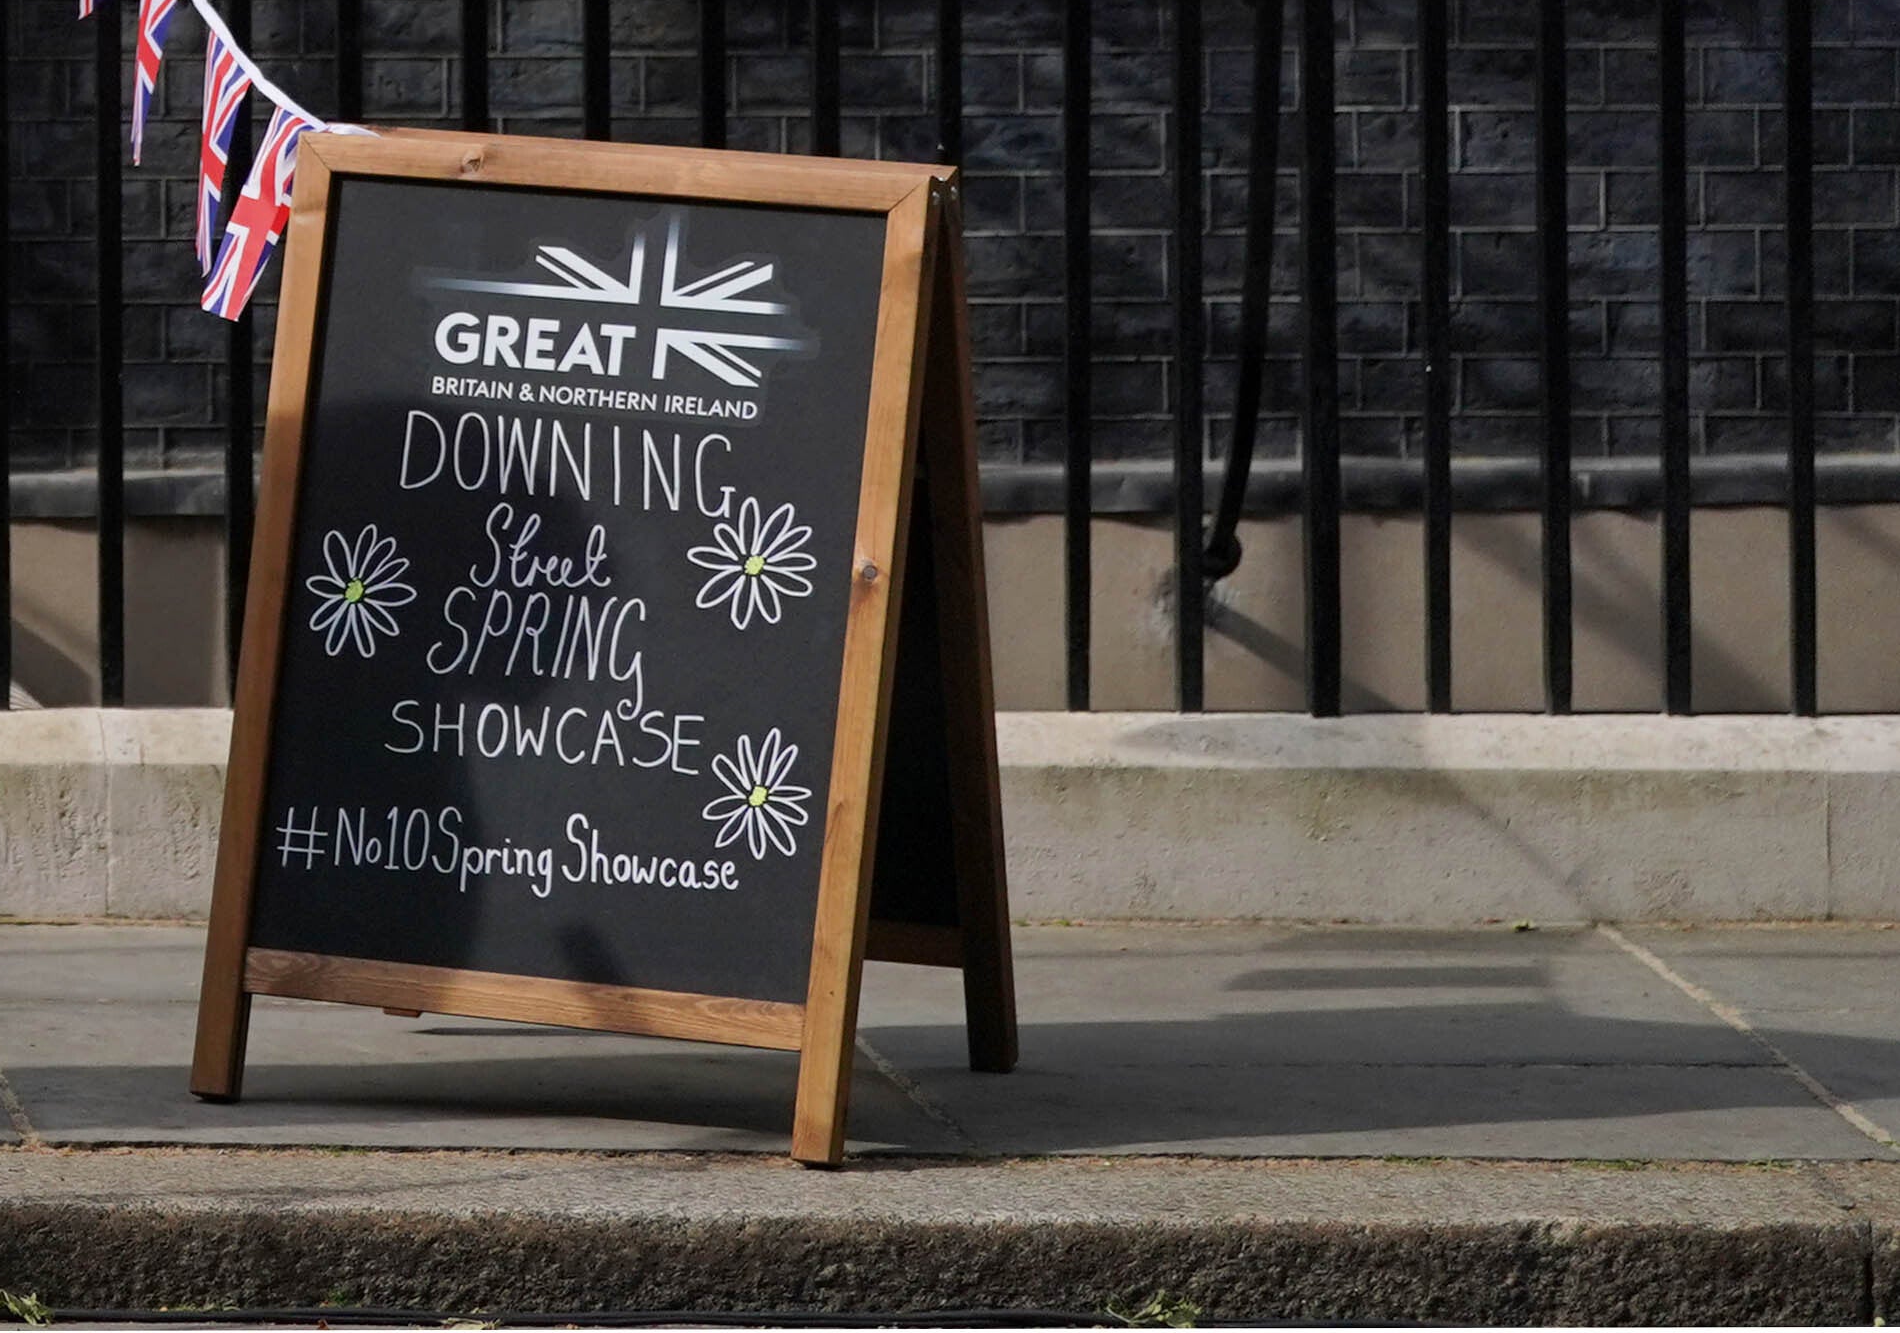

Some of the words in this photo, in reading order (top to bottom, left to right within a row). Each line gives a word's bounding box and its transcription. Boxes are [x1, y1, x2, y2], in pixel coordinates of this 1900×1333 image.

[432, 311, 637, 378] GREAT
[431, 375, 515, 401] BRITAIN
[518, 382, 536, 403] &
[538, 384, 658, 413] NORTHERN
[663, 394, 759, 420] IRELAND
[399, 409, 738, 518] DOWNING
[468, 502, 613, 589] Street
[425, 585, 647, 721] SPRING
[384, 699, 705, 776] SHOWCASE
